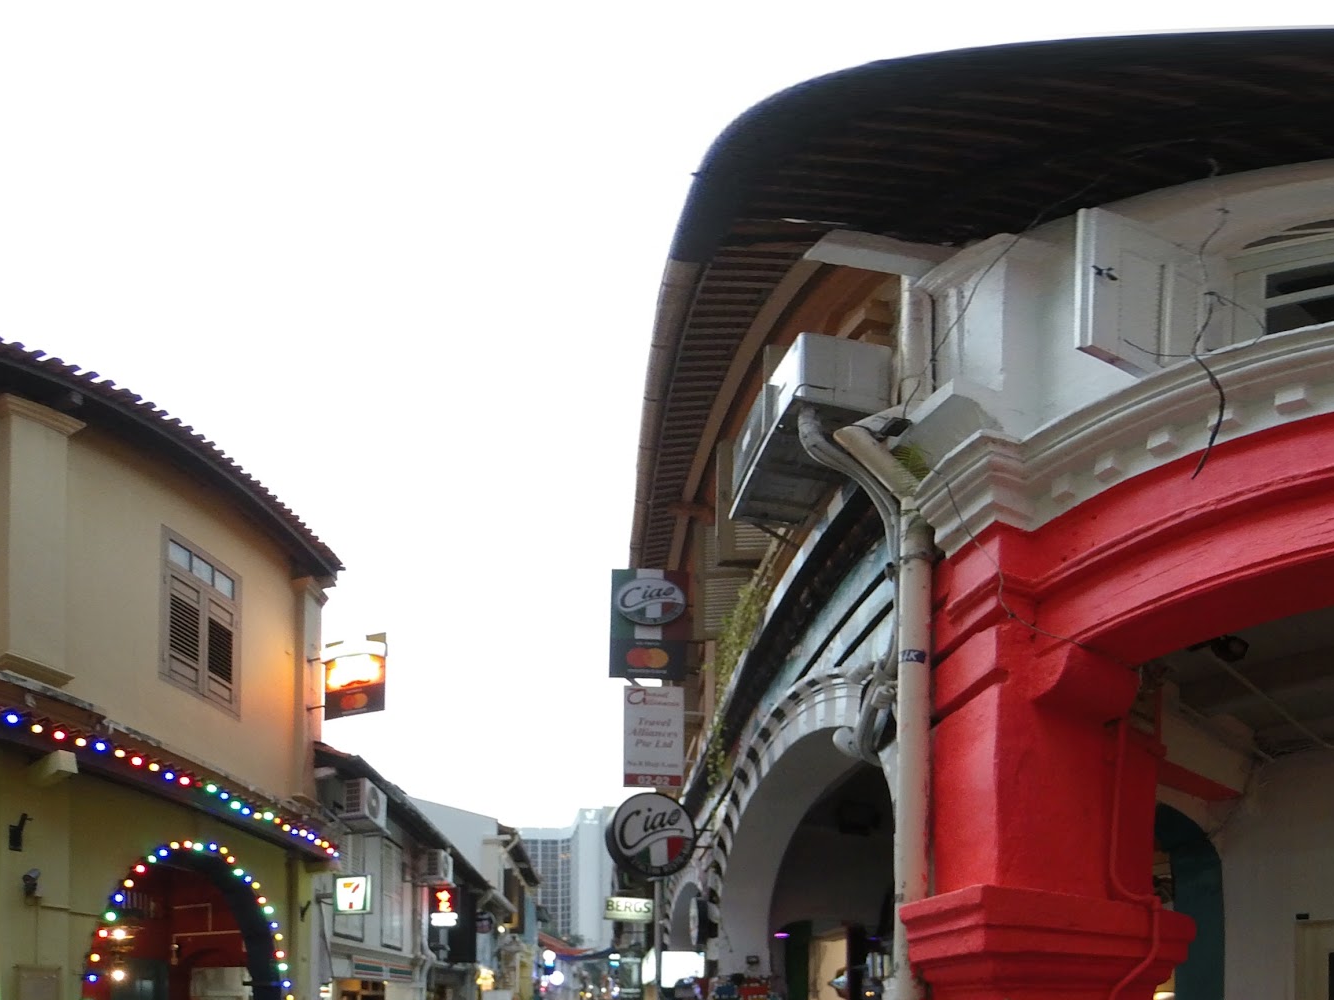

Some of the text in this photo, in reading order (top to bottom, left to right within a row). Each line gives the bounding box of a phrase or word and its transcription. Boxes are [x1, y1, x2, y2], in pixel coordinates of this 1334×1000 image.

[620, 585, 676, 609] Ciao
[619, 807, 684, 850] Ciao
[606, 900, 651, 914] BERGS
